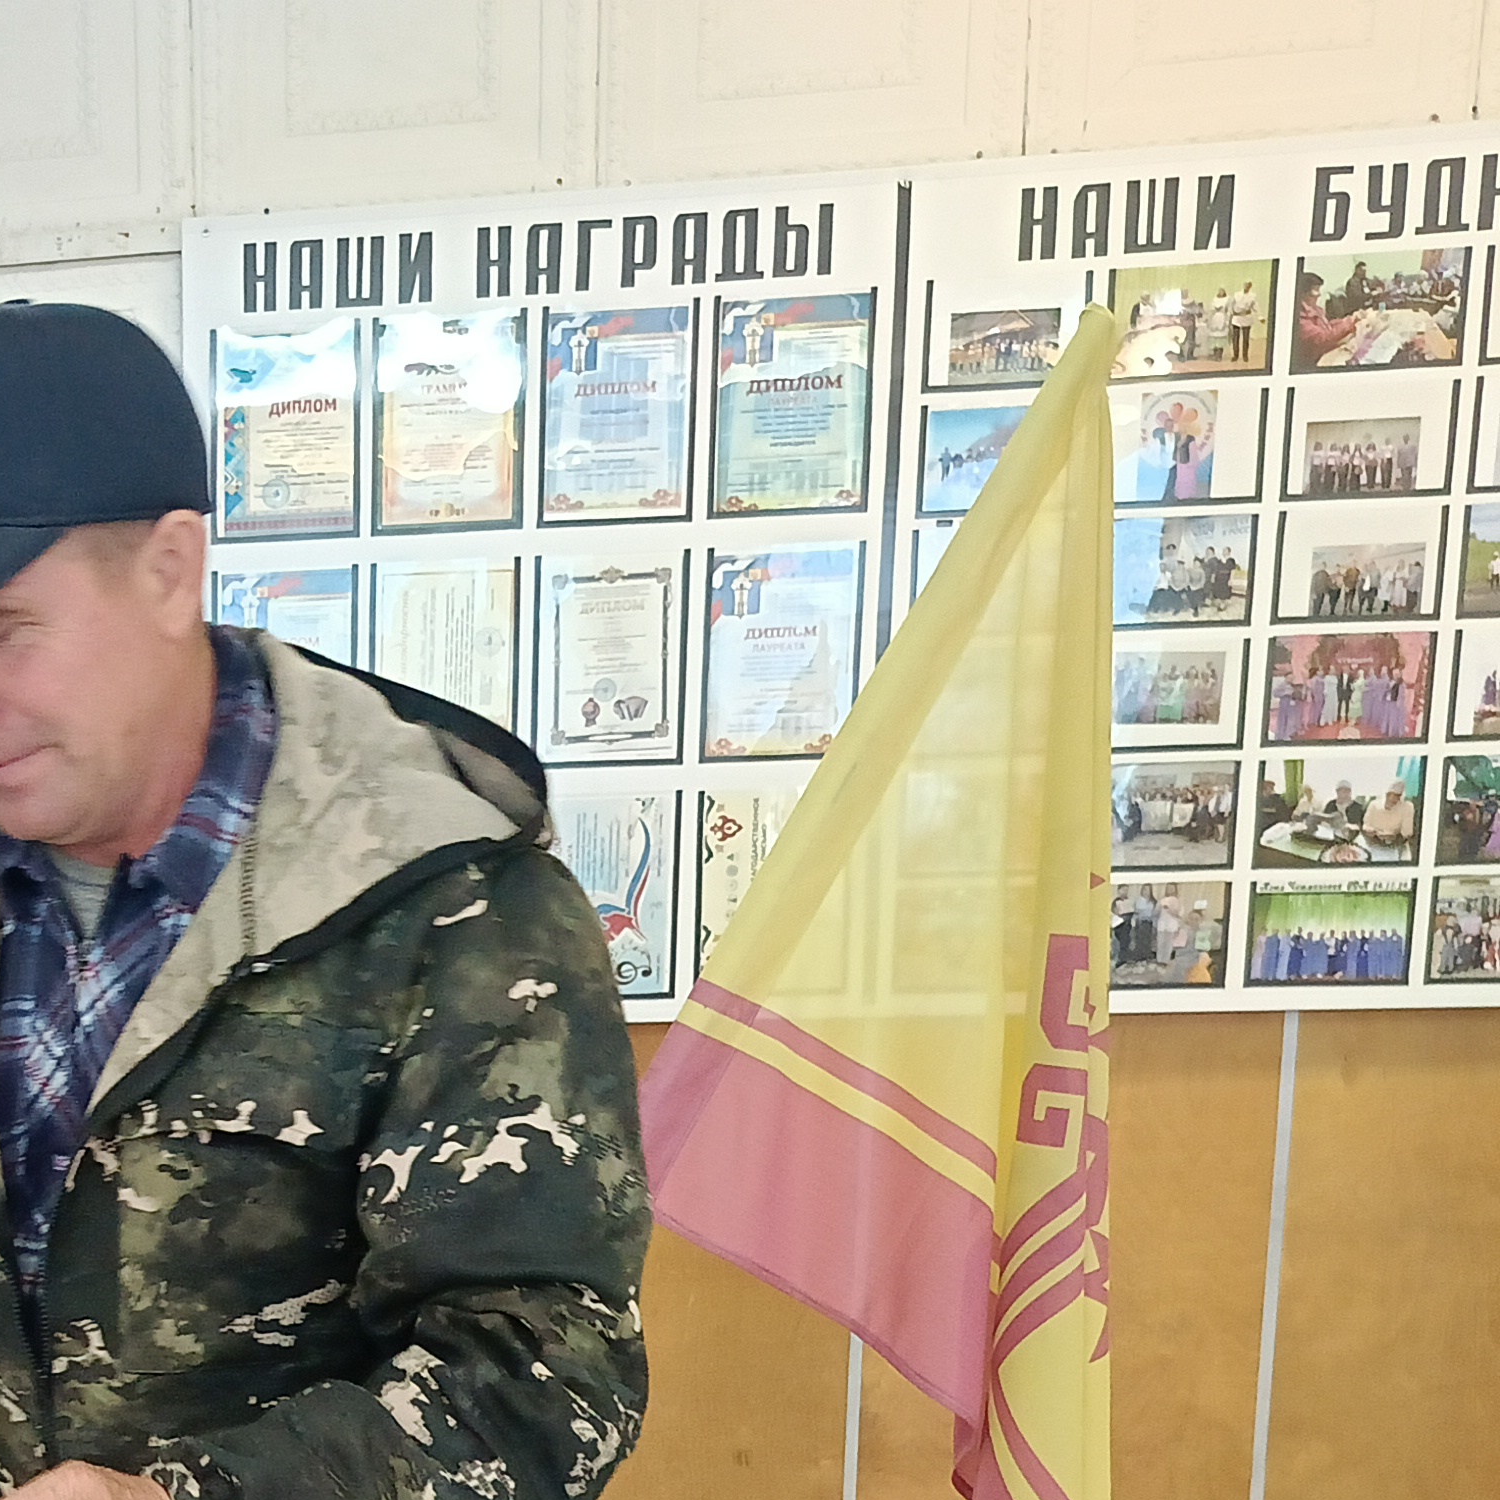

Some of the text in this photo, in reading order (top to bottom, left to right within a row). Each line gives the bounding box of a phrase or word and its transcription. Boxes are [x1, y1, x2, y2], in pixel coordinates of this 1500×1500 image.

[1018, 174, 1235, 261] НАШИ
[243, 203, 834, 313] НАШИ НАГРАДЫ
[574, 380, 657, 398] ДИПЛОМ
[746, 374, 844, 396] ДИПЛОМ
[268, 398, 337, 418] ДИПЛОМ
[744, 626, 818, 640] ДИПЛОМ
